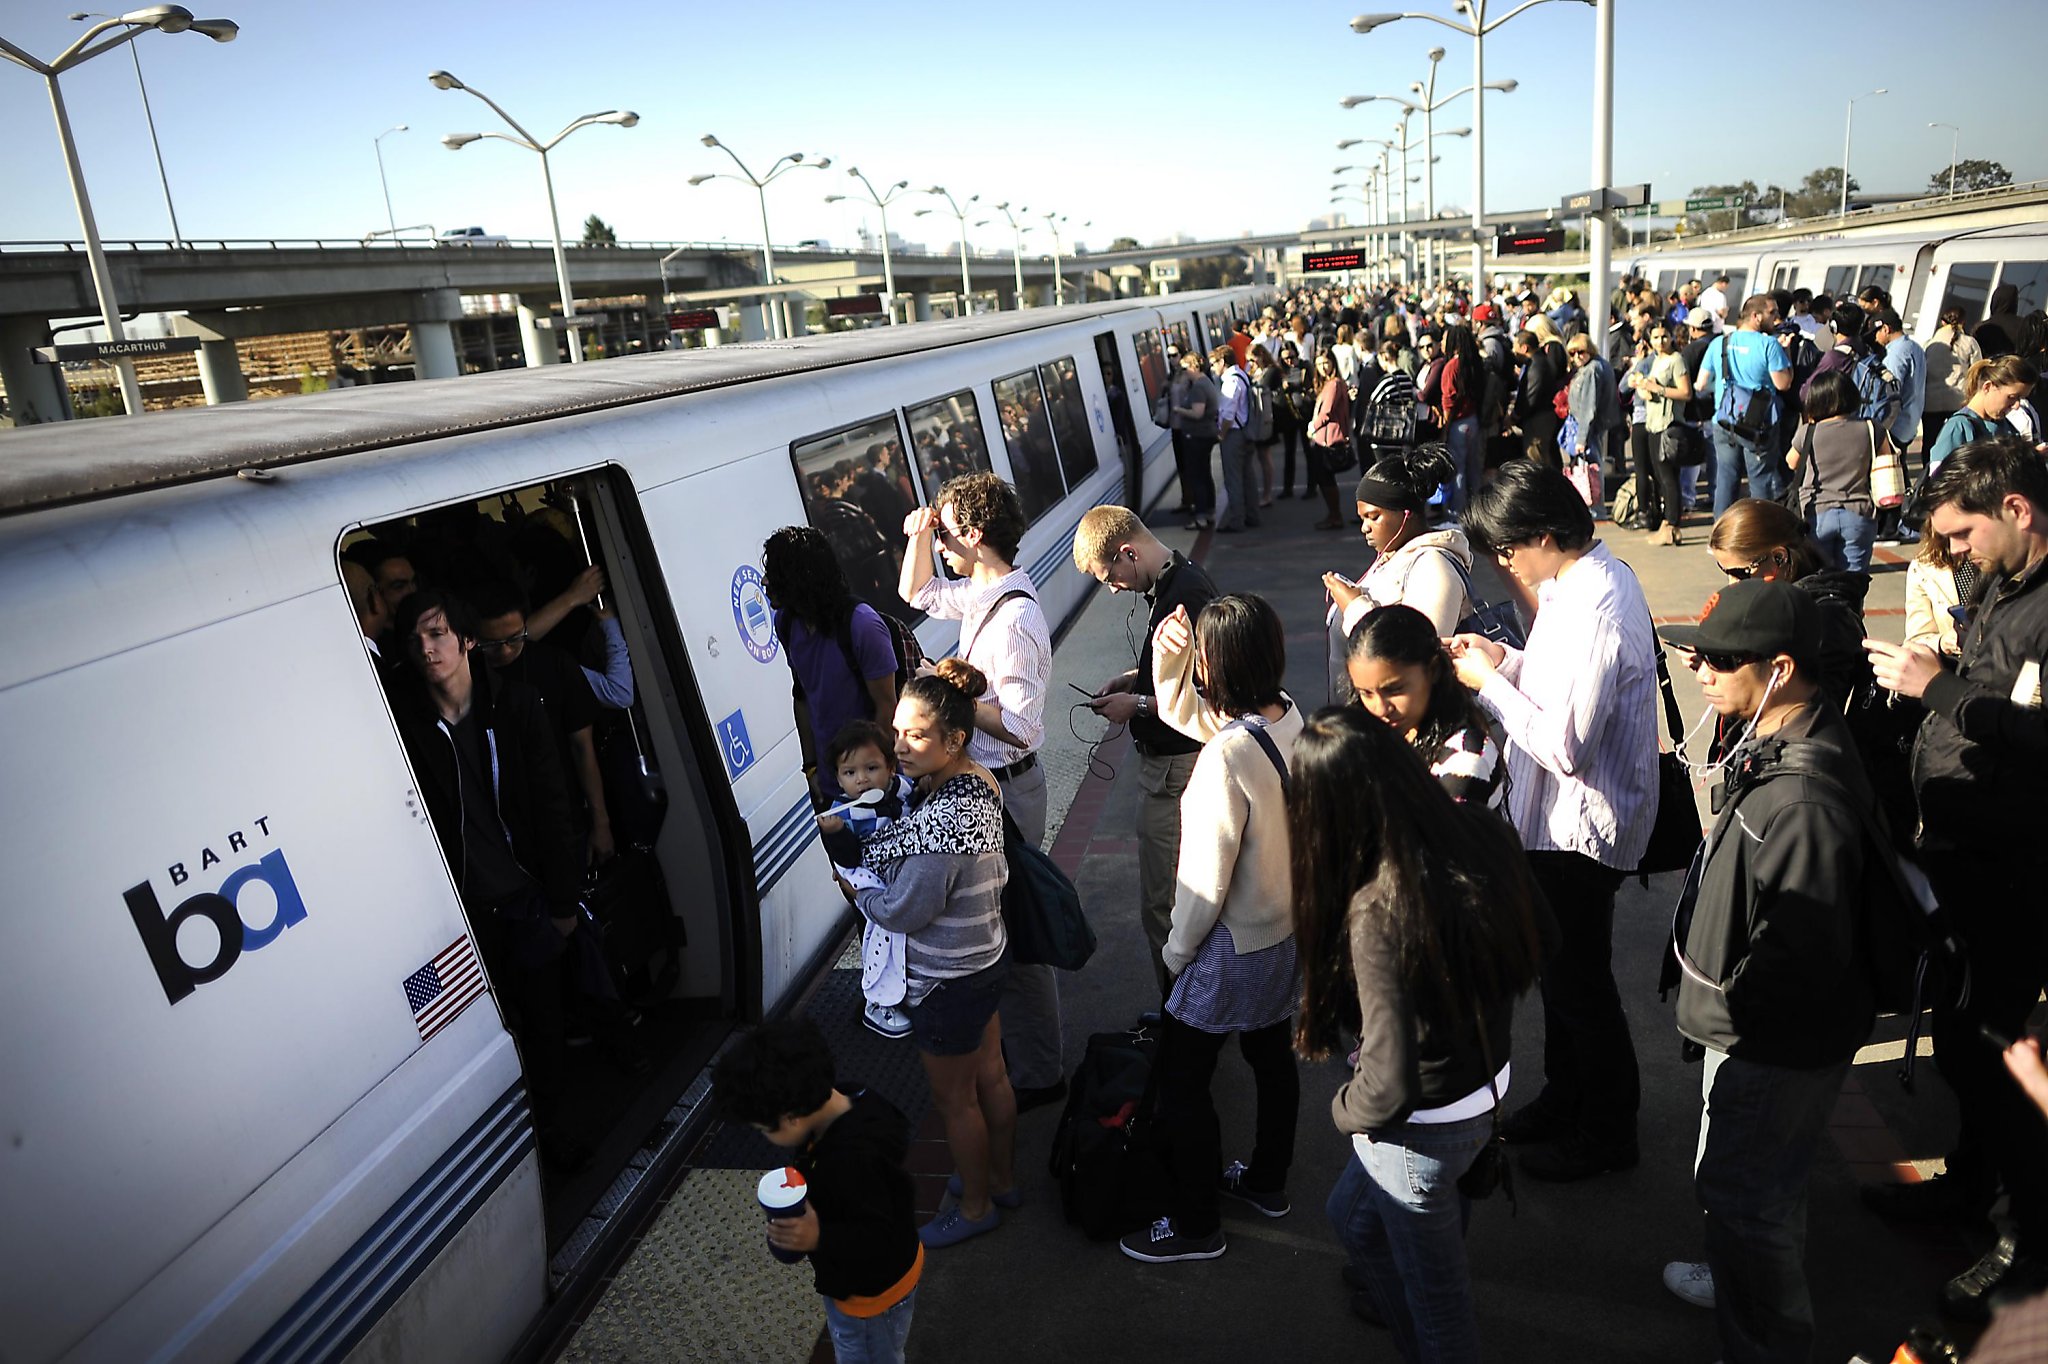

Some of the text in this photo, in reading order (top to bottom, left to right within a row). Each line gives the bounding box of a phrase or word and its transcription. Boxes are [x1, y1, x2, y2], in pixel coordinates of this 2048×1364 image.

[98, 341, 167, 354] MACARTHUR
[732, 574, 742, 608] NEW
[748, 640, 759, 657] ON
[168, 815, 269, 886] BART
[122, 848, 308, 1006] ba
